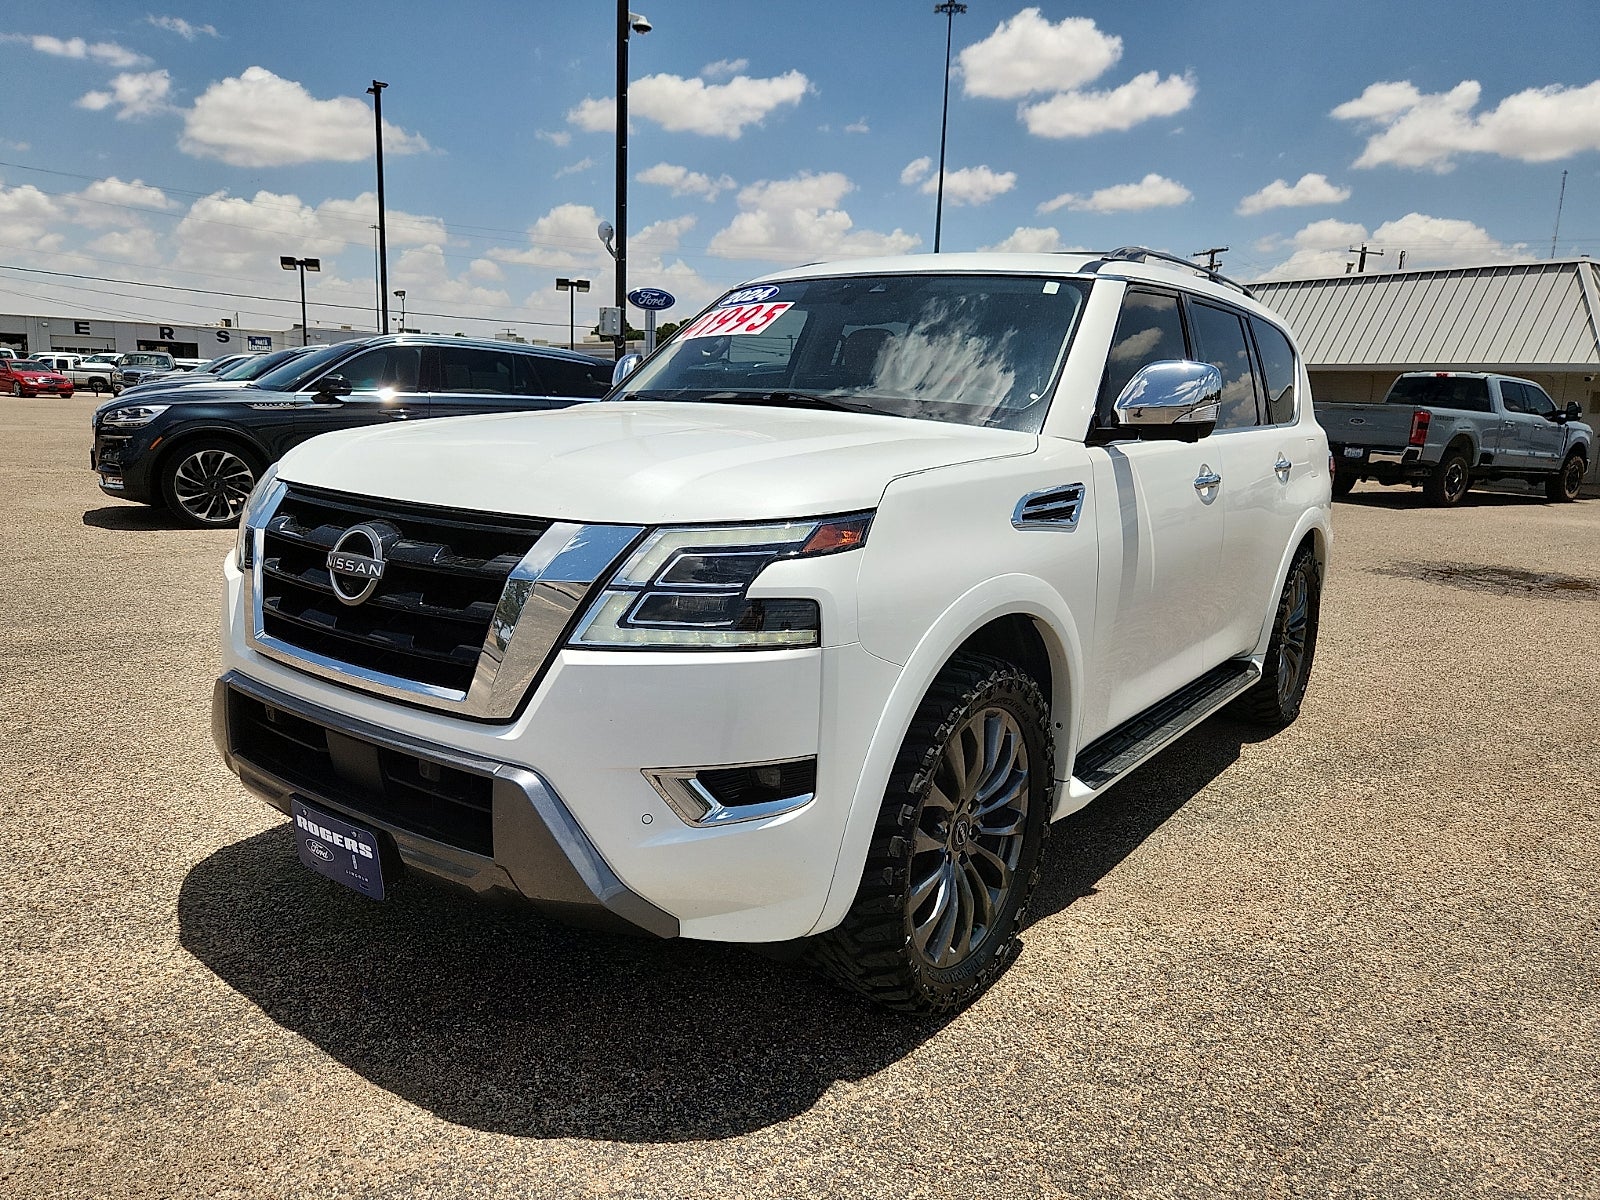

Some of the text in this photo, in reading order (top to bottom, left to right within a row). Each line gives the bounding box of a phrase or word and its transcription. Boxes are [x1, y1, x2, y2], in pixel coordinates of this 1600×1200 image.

[638, 291, 667, 306] Ford
[720, 287, 775, 306] 2024
[681, 303, 790, 340] 41995
[327, 555, 382, 577] NISSAN
[296, 814, 373, 859] ROGERS
[310, 841, 328, 859] Ford
[345, 869, 369, 882] LINCOLN
